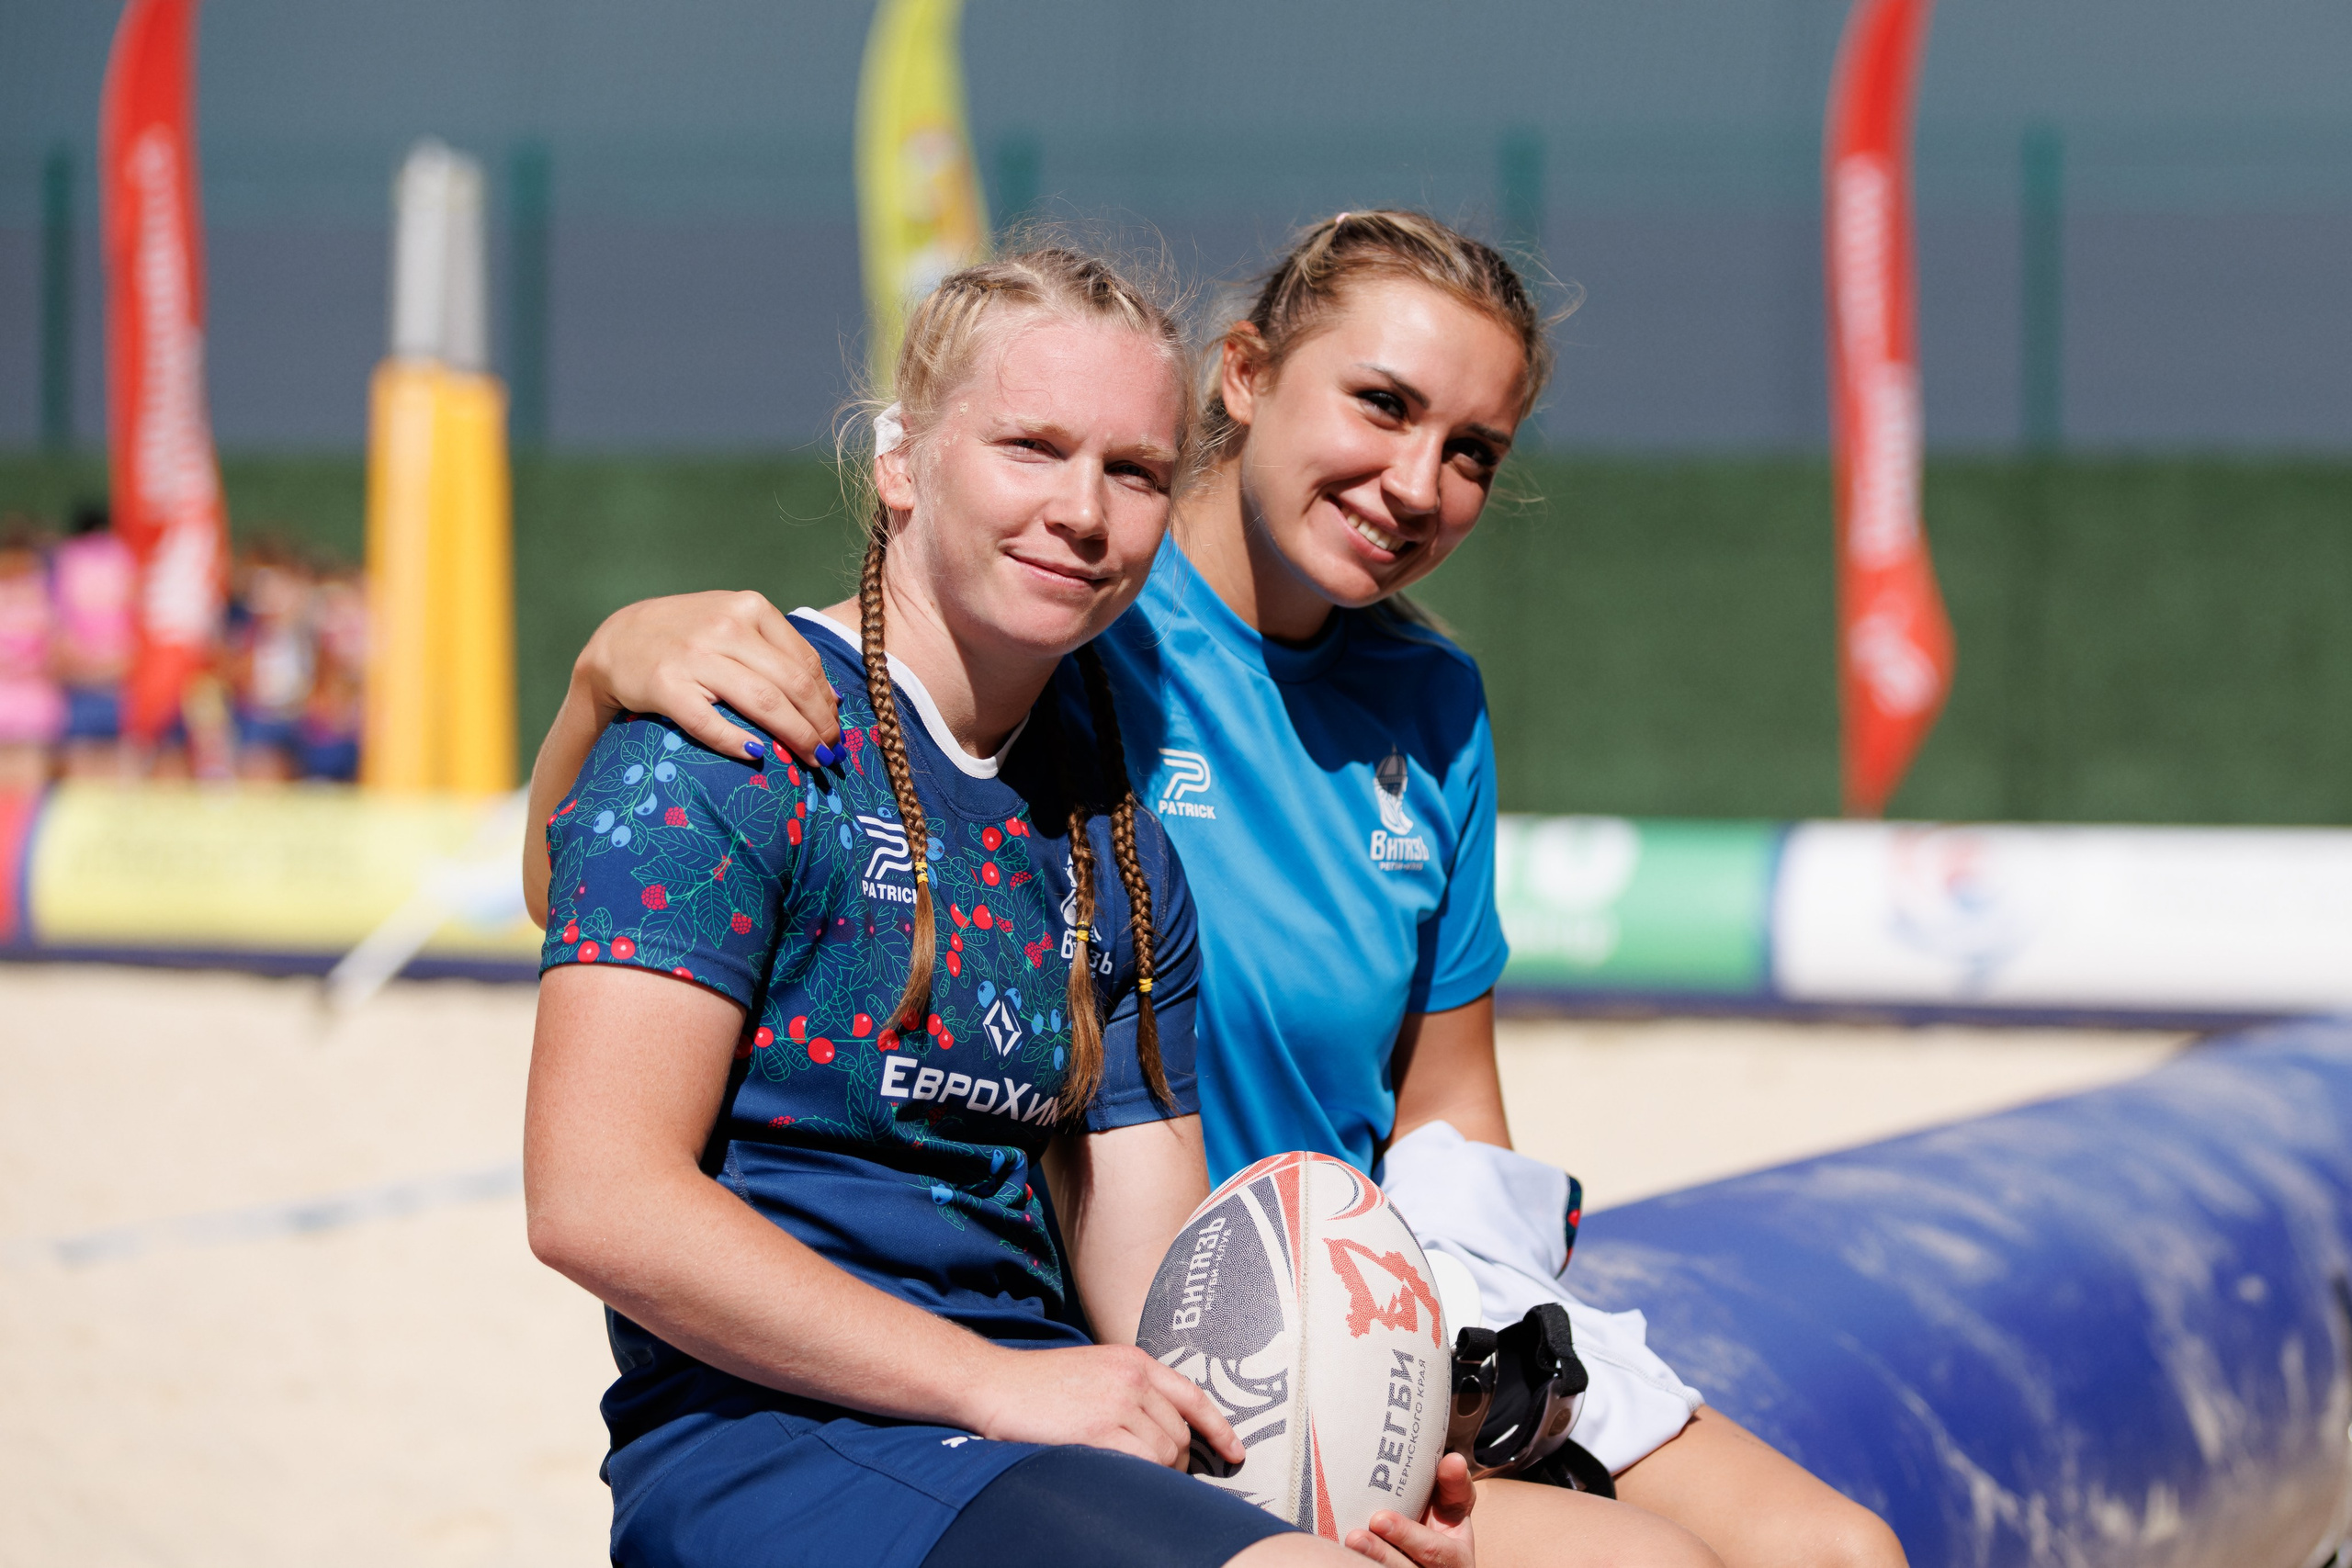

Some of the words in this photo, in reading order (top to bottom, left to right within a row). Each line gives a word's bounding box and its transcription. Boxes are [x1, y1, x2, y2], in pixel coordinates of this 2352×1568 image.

[1159, 799, 1216, 819] PATRICK
[1368, 1348, 1415, 1493] РЕГБИ
[1396, 1402, 1423, 1497] ПЕРМСКОГО
[1417, 1359, 1426, 1398] КРАЯ
